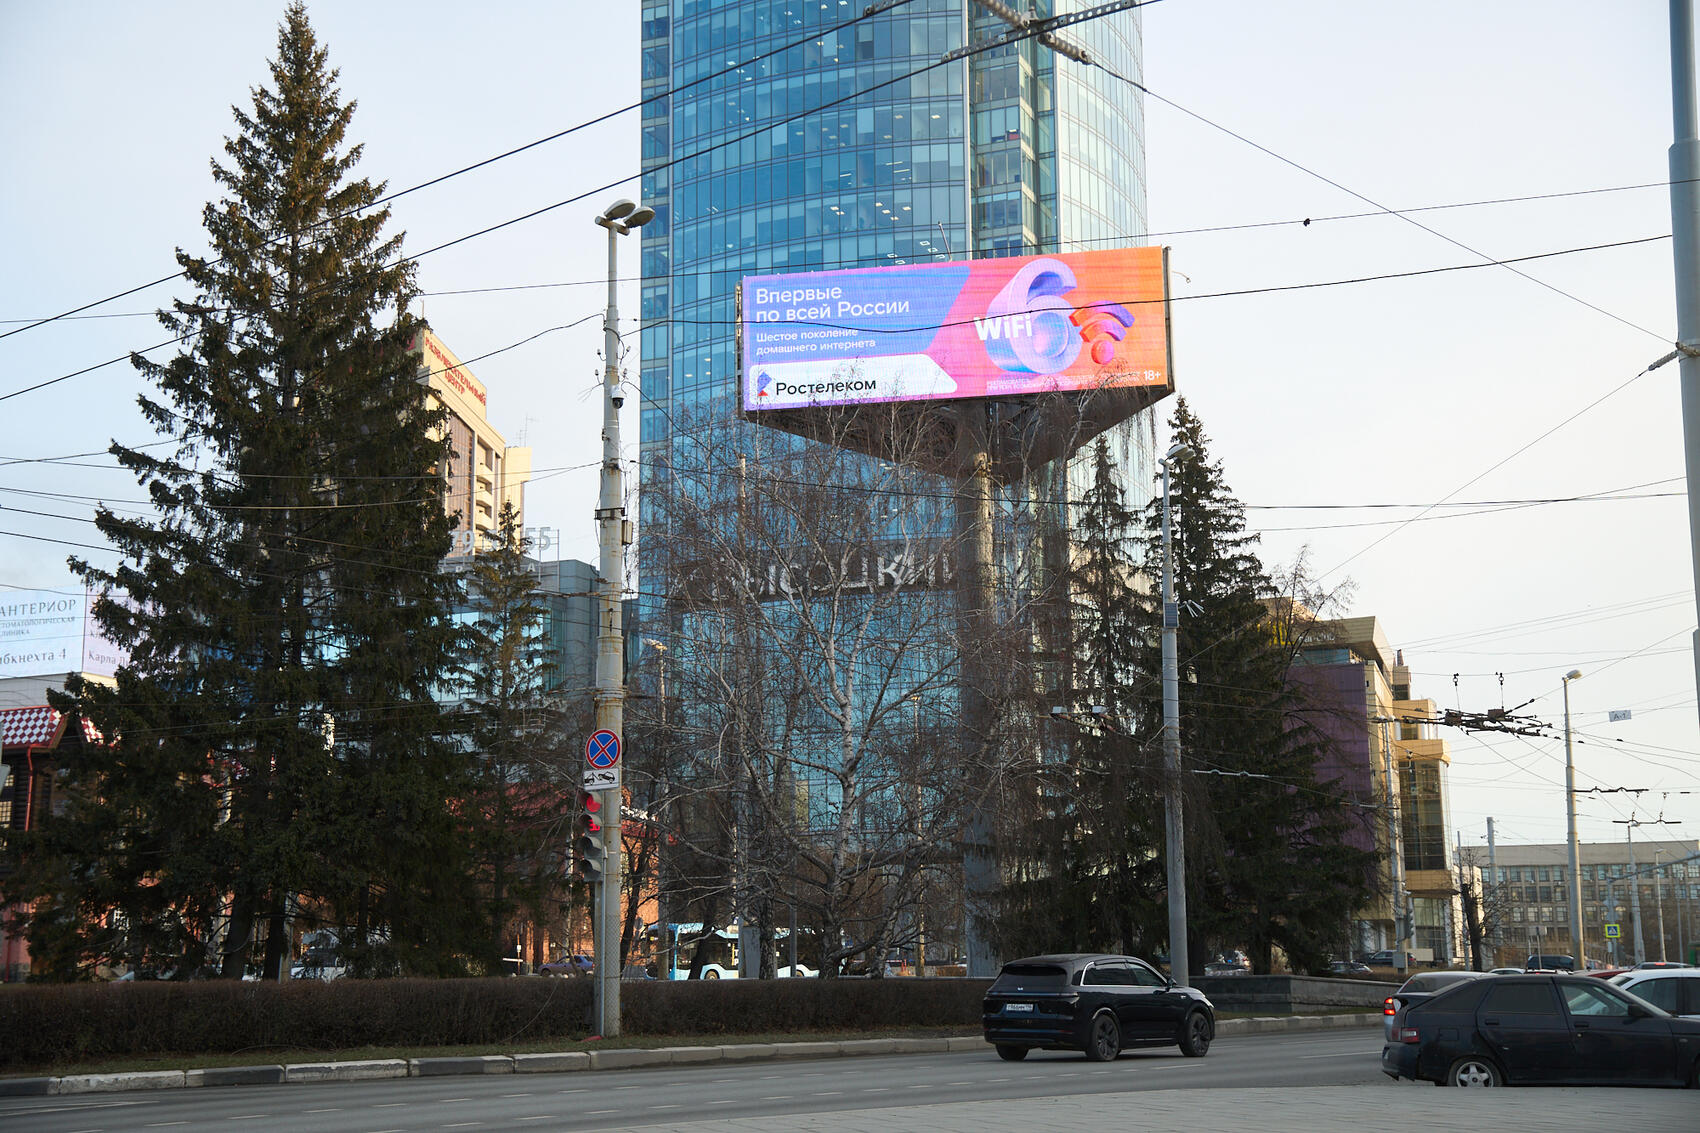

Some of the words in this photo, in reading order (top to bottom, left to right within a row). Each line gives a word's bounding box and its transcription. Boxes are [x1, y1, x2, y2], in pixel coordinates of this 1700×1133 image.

[756, 287, 842, 306] Впервые
[756, 310, 779, 322] по
[787, 305, 831, 322] всей
[838, 300, 910, 317] России
[756, 331, 798, 343] Шестое
[801, 329, 859, 340] поколение
[974, 314, 1032, 341] WiFi
[756, 344, 817, 356] домашнего
[820, 339, 876, 352] интернета
[444, 369, 466, 395] ЦЕНТР
[1143, 370, 1161, 381] 18+
[776, 380, 876, 396] Ростелеком
[88, 650, 116, 666] Карла
